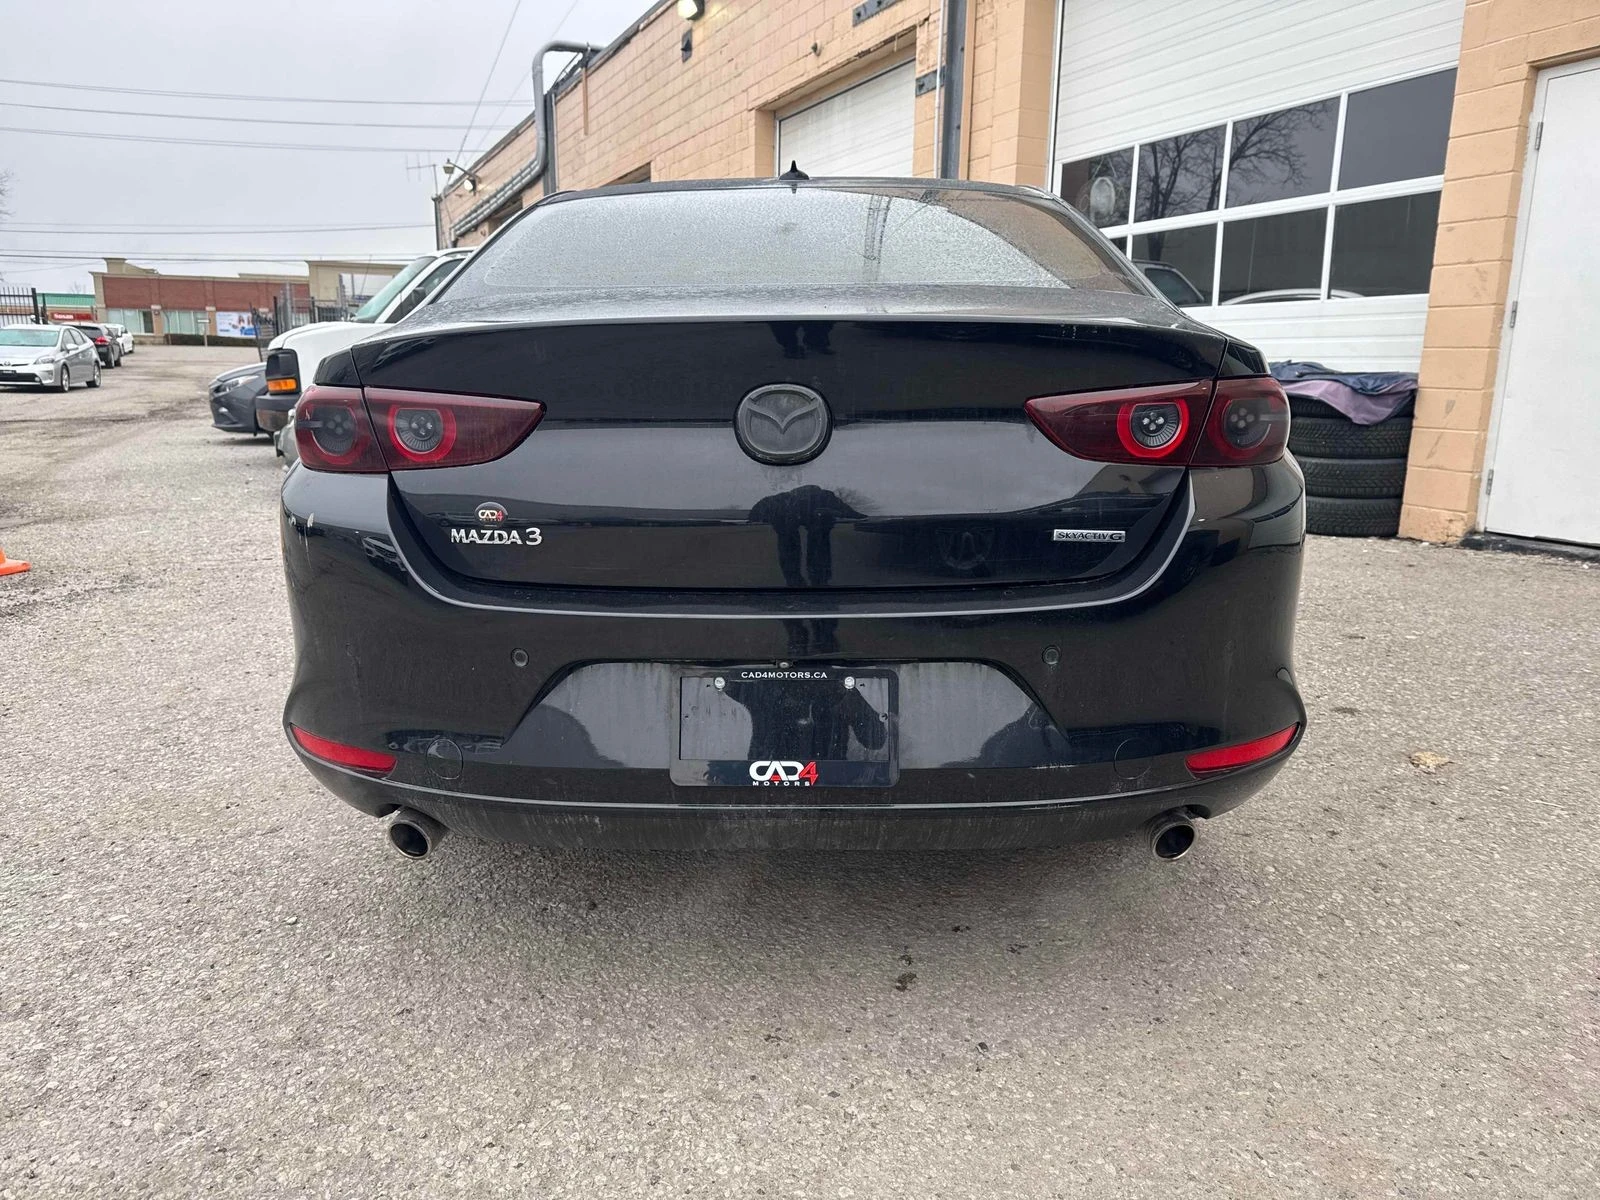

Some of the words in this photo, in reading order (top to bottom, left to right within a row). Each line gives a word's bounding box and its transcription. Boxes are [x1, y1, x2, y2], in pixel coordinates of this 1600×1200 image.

[450, 528, 523, 545] MAZDA
[741, 671, 828, 679] CAD4MOTORS.CA
[749, 760, 819, 785] CAD4
